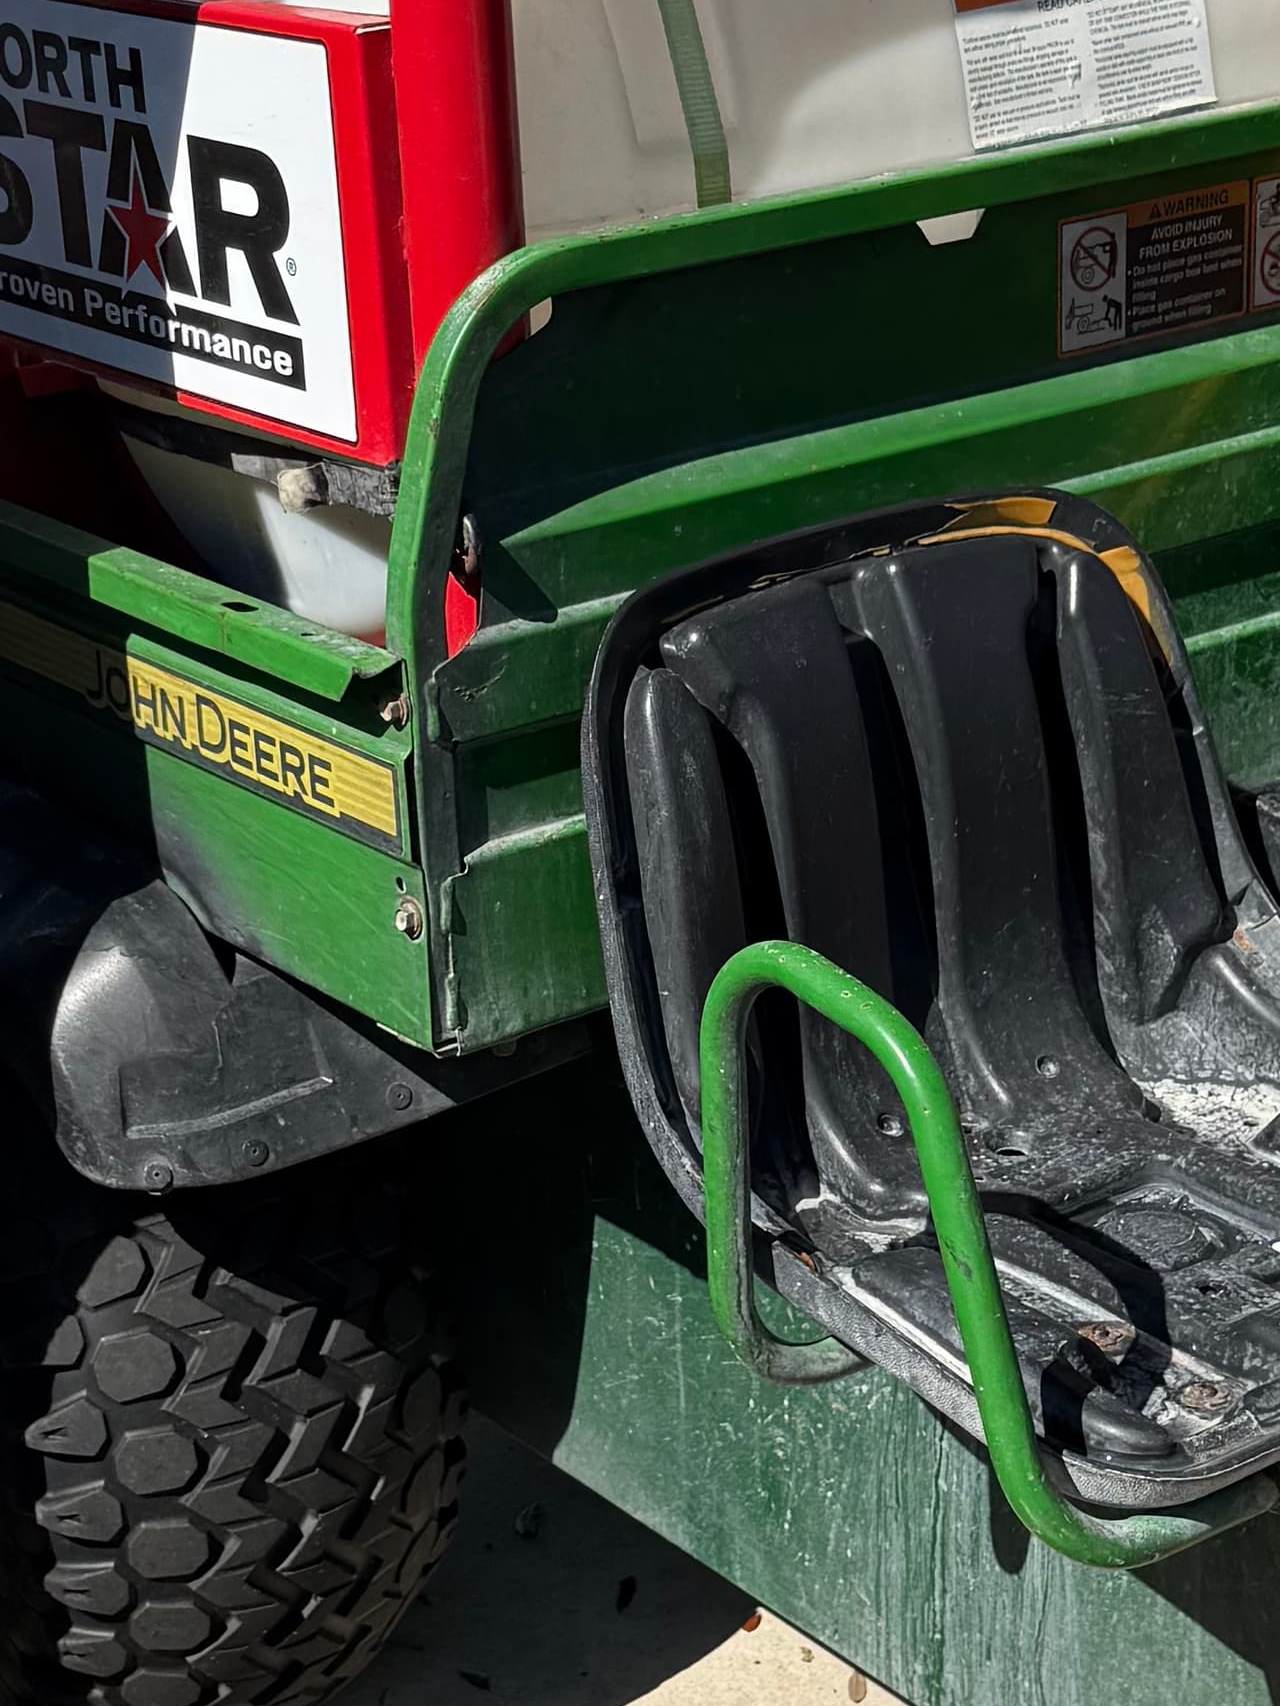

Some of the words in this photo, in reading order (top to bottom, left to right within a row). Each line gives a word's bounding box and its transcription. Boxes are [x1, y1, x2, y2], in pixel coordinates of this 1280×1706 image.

[1163, 189, 1229, 216] WARNING
[1151, 223, 1184, 241] AVOID
[1185, 214, 1224, 233] INJURY
[1139, 242, 1170, 260] FROM
[1172, 229, 1233, 252] EXPLOSION
[83, 292, 294, 378] Performance
[87, 650, 188, 741] JOHN
[195, 693, 335, 809] DEERE
